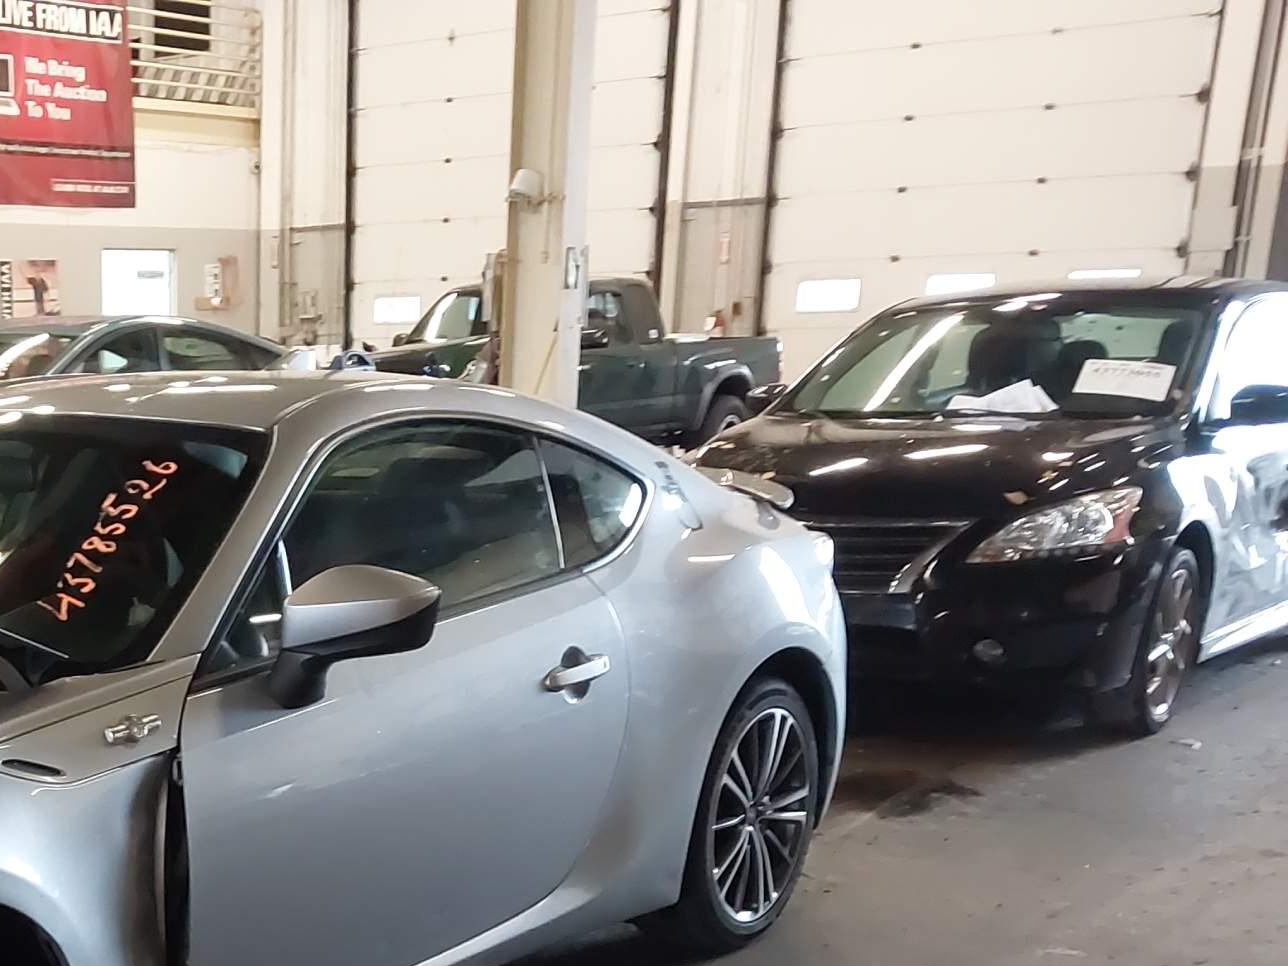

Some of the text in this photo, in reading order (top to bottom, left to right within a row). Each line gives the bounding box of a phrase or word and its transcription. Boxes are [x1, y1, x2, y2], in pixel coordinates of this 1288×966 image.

[35, 3, 87, 34] FROM
[89, 10, 123, 38] IAA
[47, 59, 86, 83] Bring
[24, 79, 107, 102] The Auction
[24, 100, 72, 120] To You
